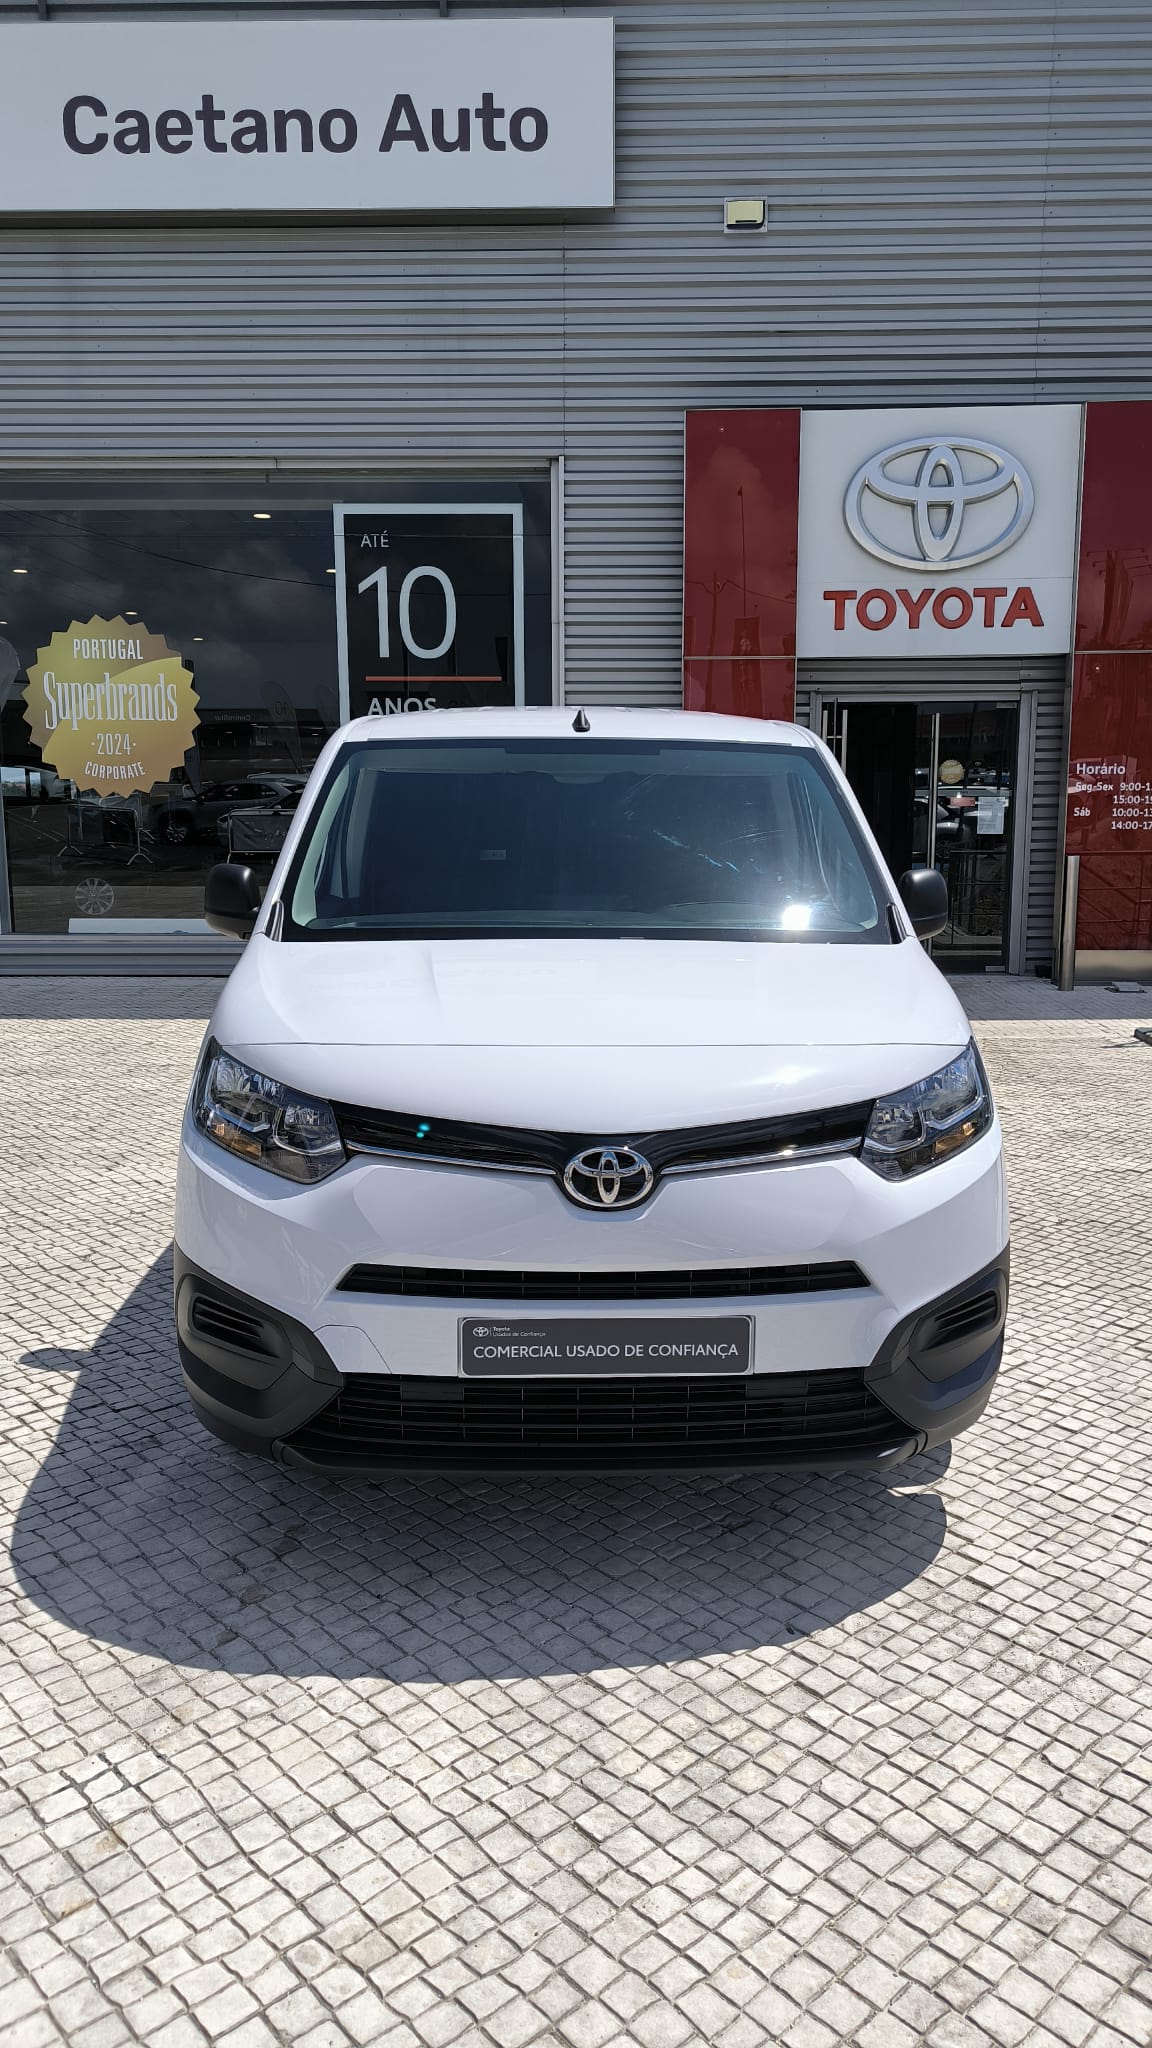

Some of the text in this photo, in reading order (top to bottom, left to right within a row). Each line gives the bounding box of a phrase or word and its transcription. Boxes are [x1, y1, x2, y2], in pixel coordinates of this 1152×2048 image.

[62, 92, 549, 155] Caetano Auto
[360, 530, 390, 548] ATÉ
[358, 565, 457, 659] 10
[823, 586, 1045, 631] TOYOTA
[73, 638, 144, 660] PORTUGAL
[43, 671, 178, 731] Superbrands
[84, 761, 146, 780] CORPORATE
[1076, 763, 1126, 775] Horário
[1120, 782, 1152, 791] 9:00-1
[1073, 807, 1091, 817] Sáb
[473, 1344, 739, 1358] COMERCIAL USADO DE CONFIANÇA
